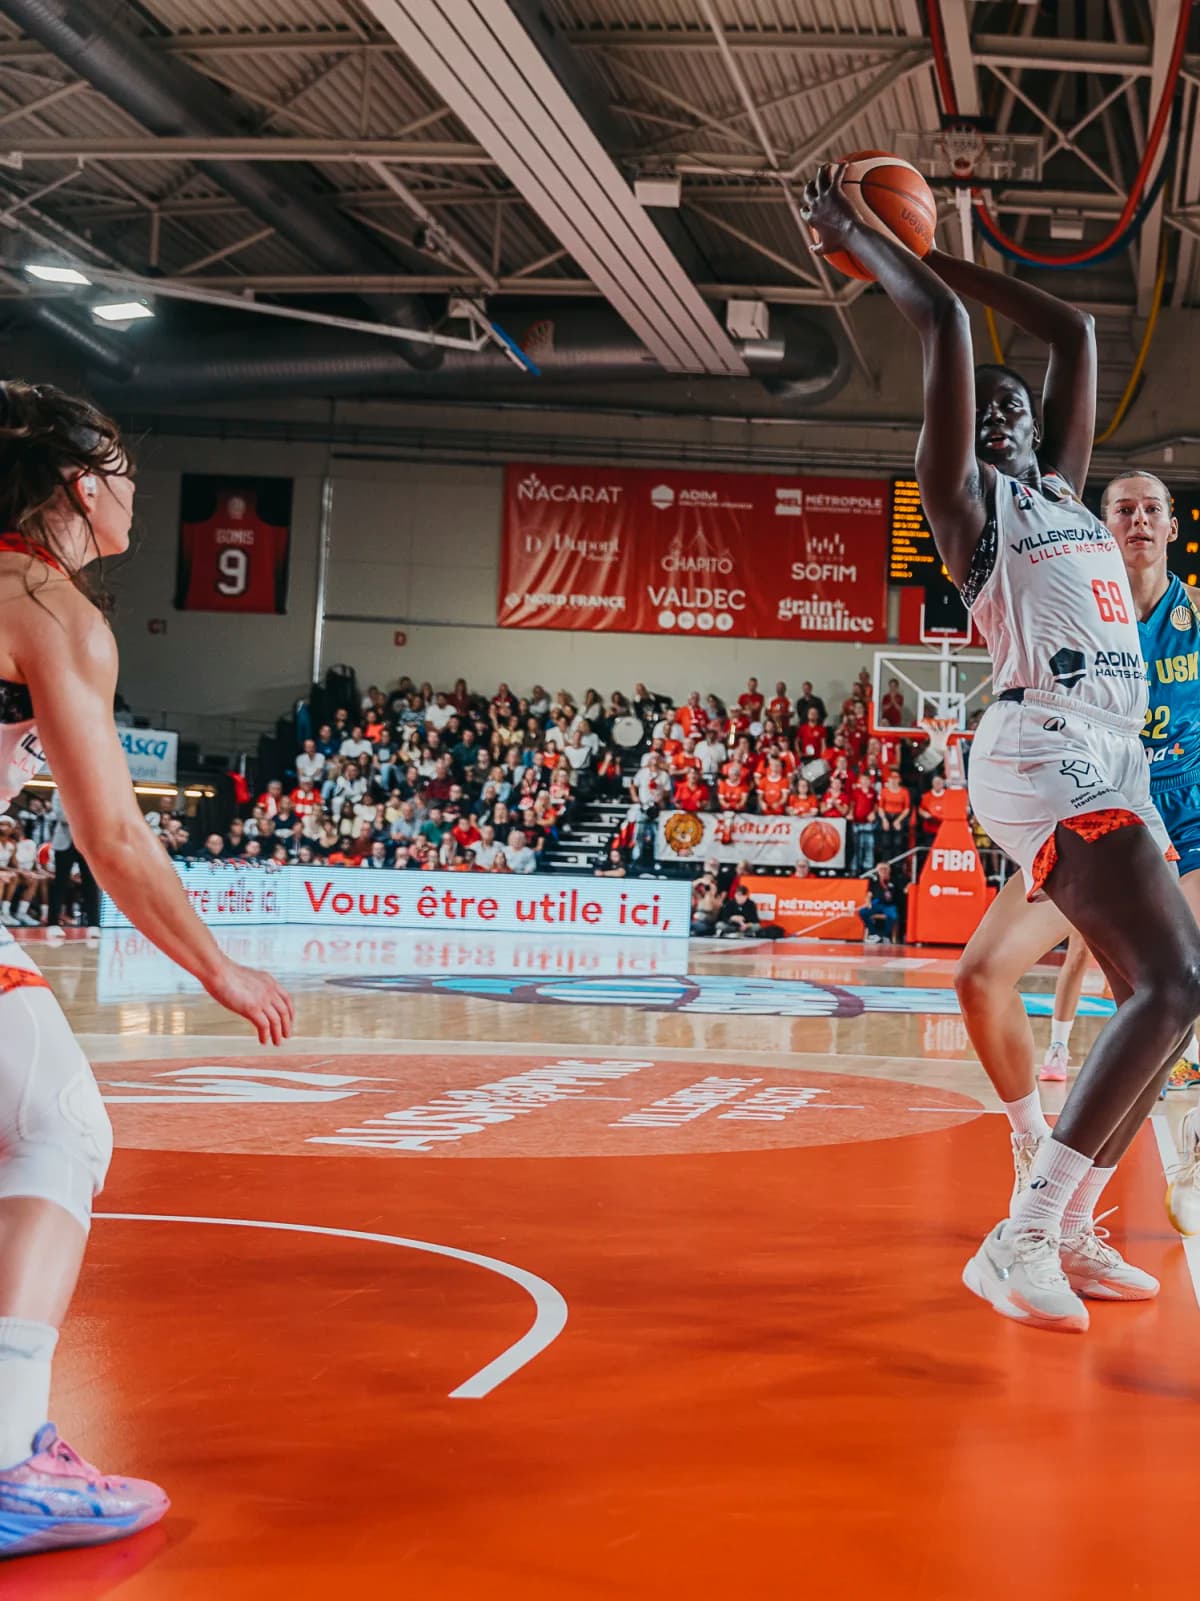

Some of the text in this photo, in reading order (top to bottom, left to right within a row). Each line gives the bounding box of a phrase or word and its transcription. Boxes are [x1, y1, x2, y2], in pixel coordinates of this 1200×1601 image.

[517, 483, 623, 503] NACARAT
[679, 490, 717, 500] ADIM
[805, 494, 882, 508] MÉTROPOLE
[661, 556, 733, 574] CHAPITO
[1030, 545, 1071, 565] LILLE
[218, 549, 247, 595] 9
[791, 563, 857, 582] SOFIM
[570, 594, 626, 609] FRANCE
[647, 586, 746, 611] VALDEC
[778, 594, 832, 620] grain
[1091, 579, 1129, 624] 69
[800, 609, 874, 633] malice
[1095, 651, 1141, 668] ADIM
[931, 848, 976, 872] FIBA
[304, 881, 672, 931] Vous être utile ici,
